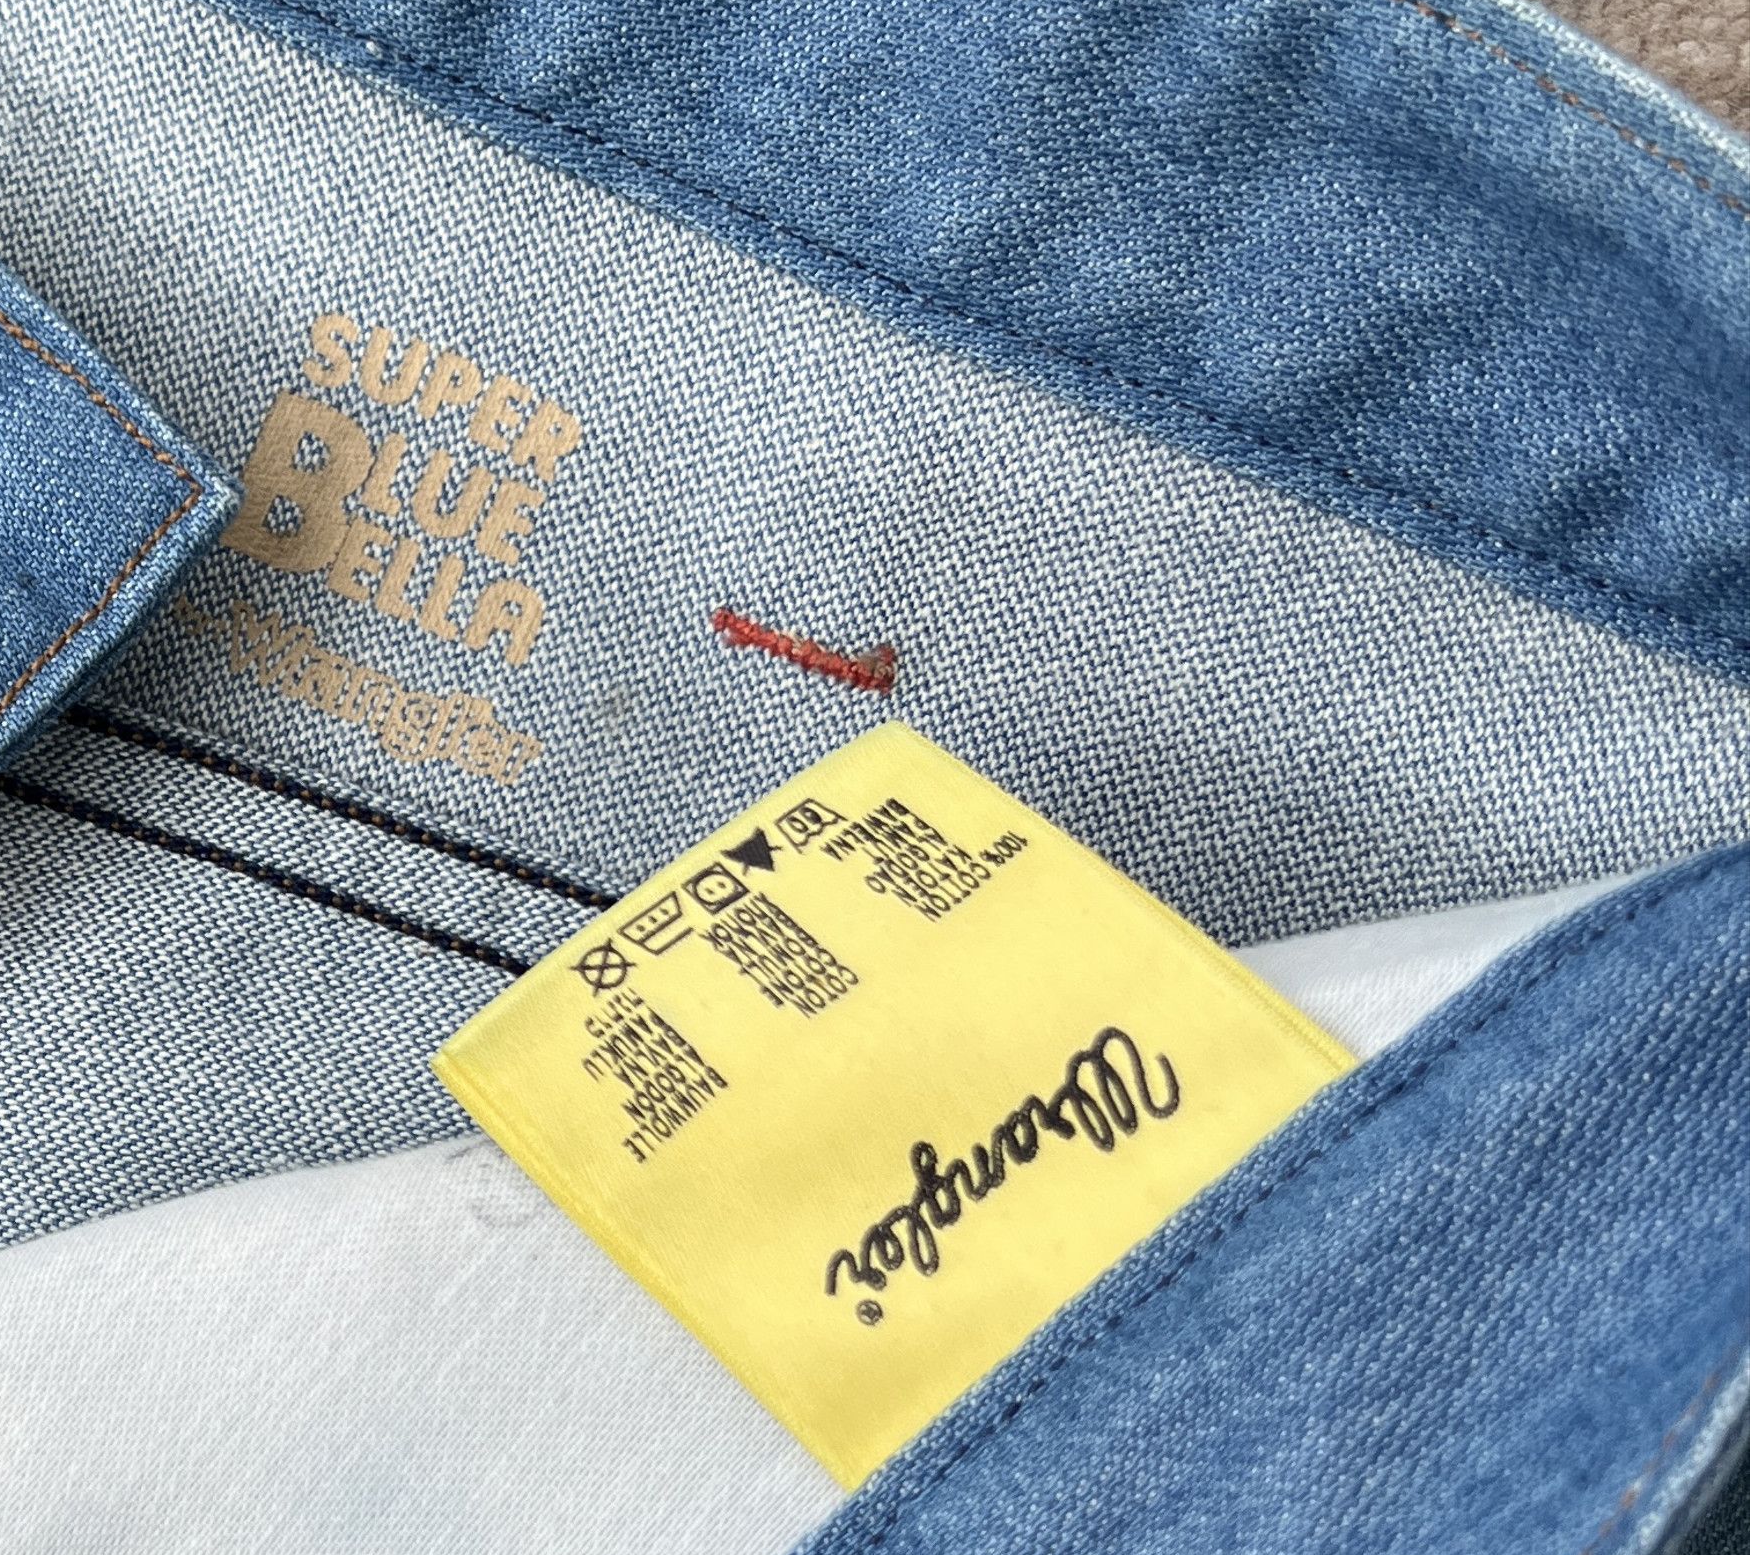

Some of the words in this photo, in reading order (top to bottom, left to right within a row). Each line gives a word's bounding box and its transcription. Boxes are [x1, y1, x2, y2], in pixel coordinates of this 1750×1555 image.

[302, 313, 581, 481] SUPER
[228, 599, 542, 785] Wrangler
[861, 813, 930, 865] PAMUT
[977, 830, 1027, 867] 100%
[890, 844, 972, 907] KATOEN
[913, 861, 991, 922] COTTON
[738, 926, 818, 986] BOMULL
[759, 945, 837, 1008] COTONE
[790, 964, 858, 1019] COTON
[581, 1006, 666, 1082] PAMUKLU
[612, 1023, 686, 1089] BAVLNA
[621, 1065, 728, 1163] BAUMWOLLE
